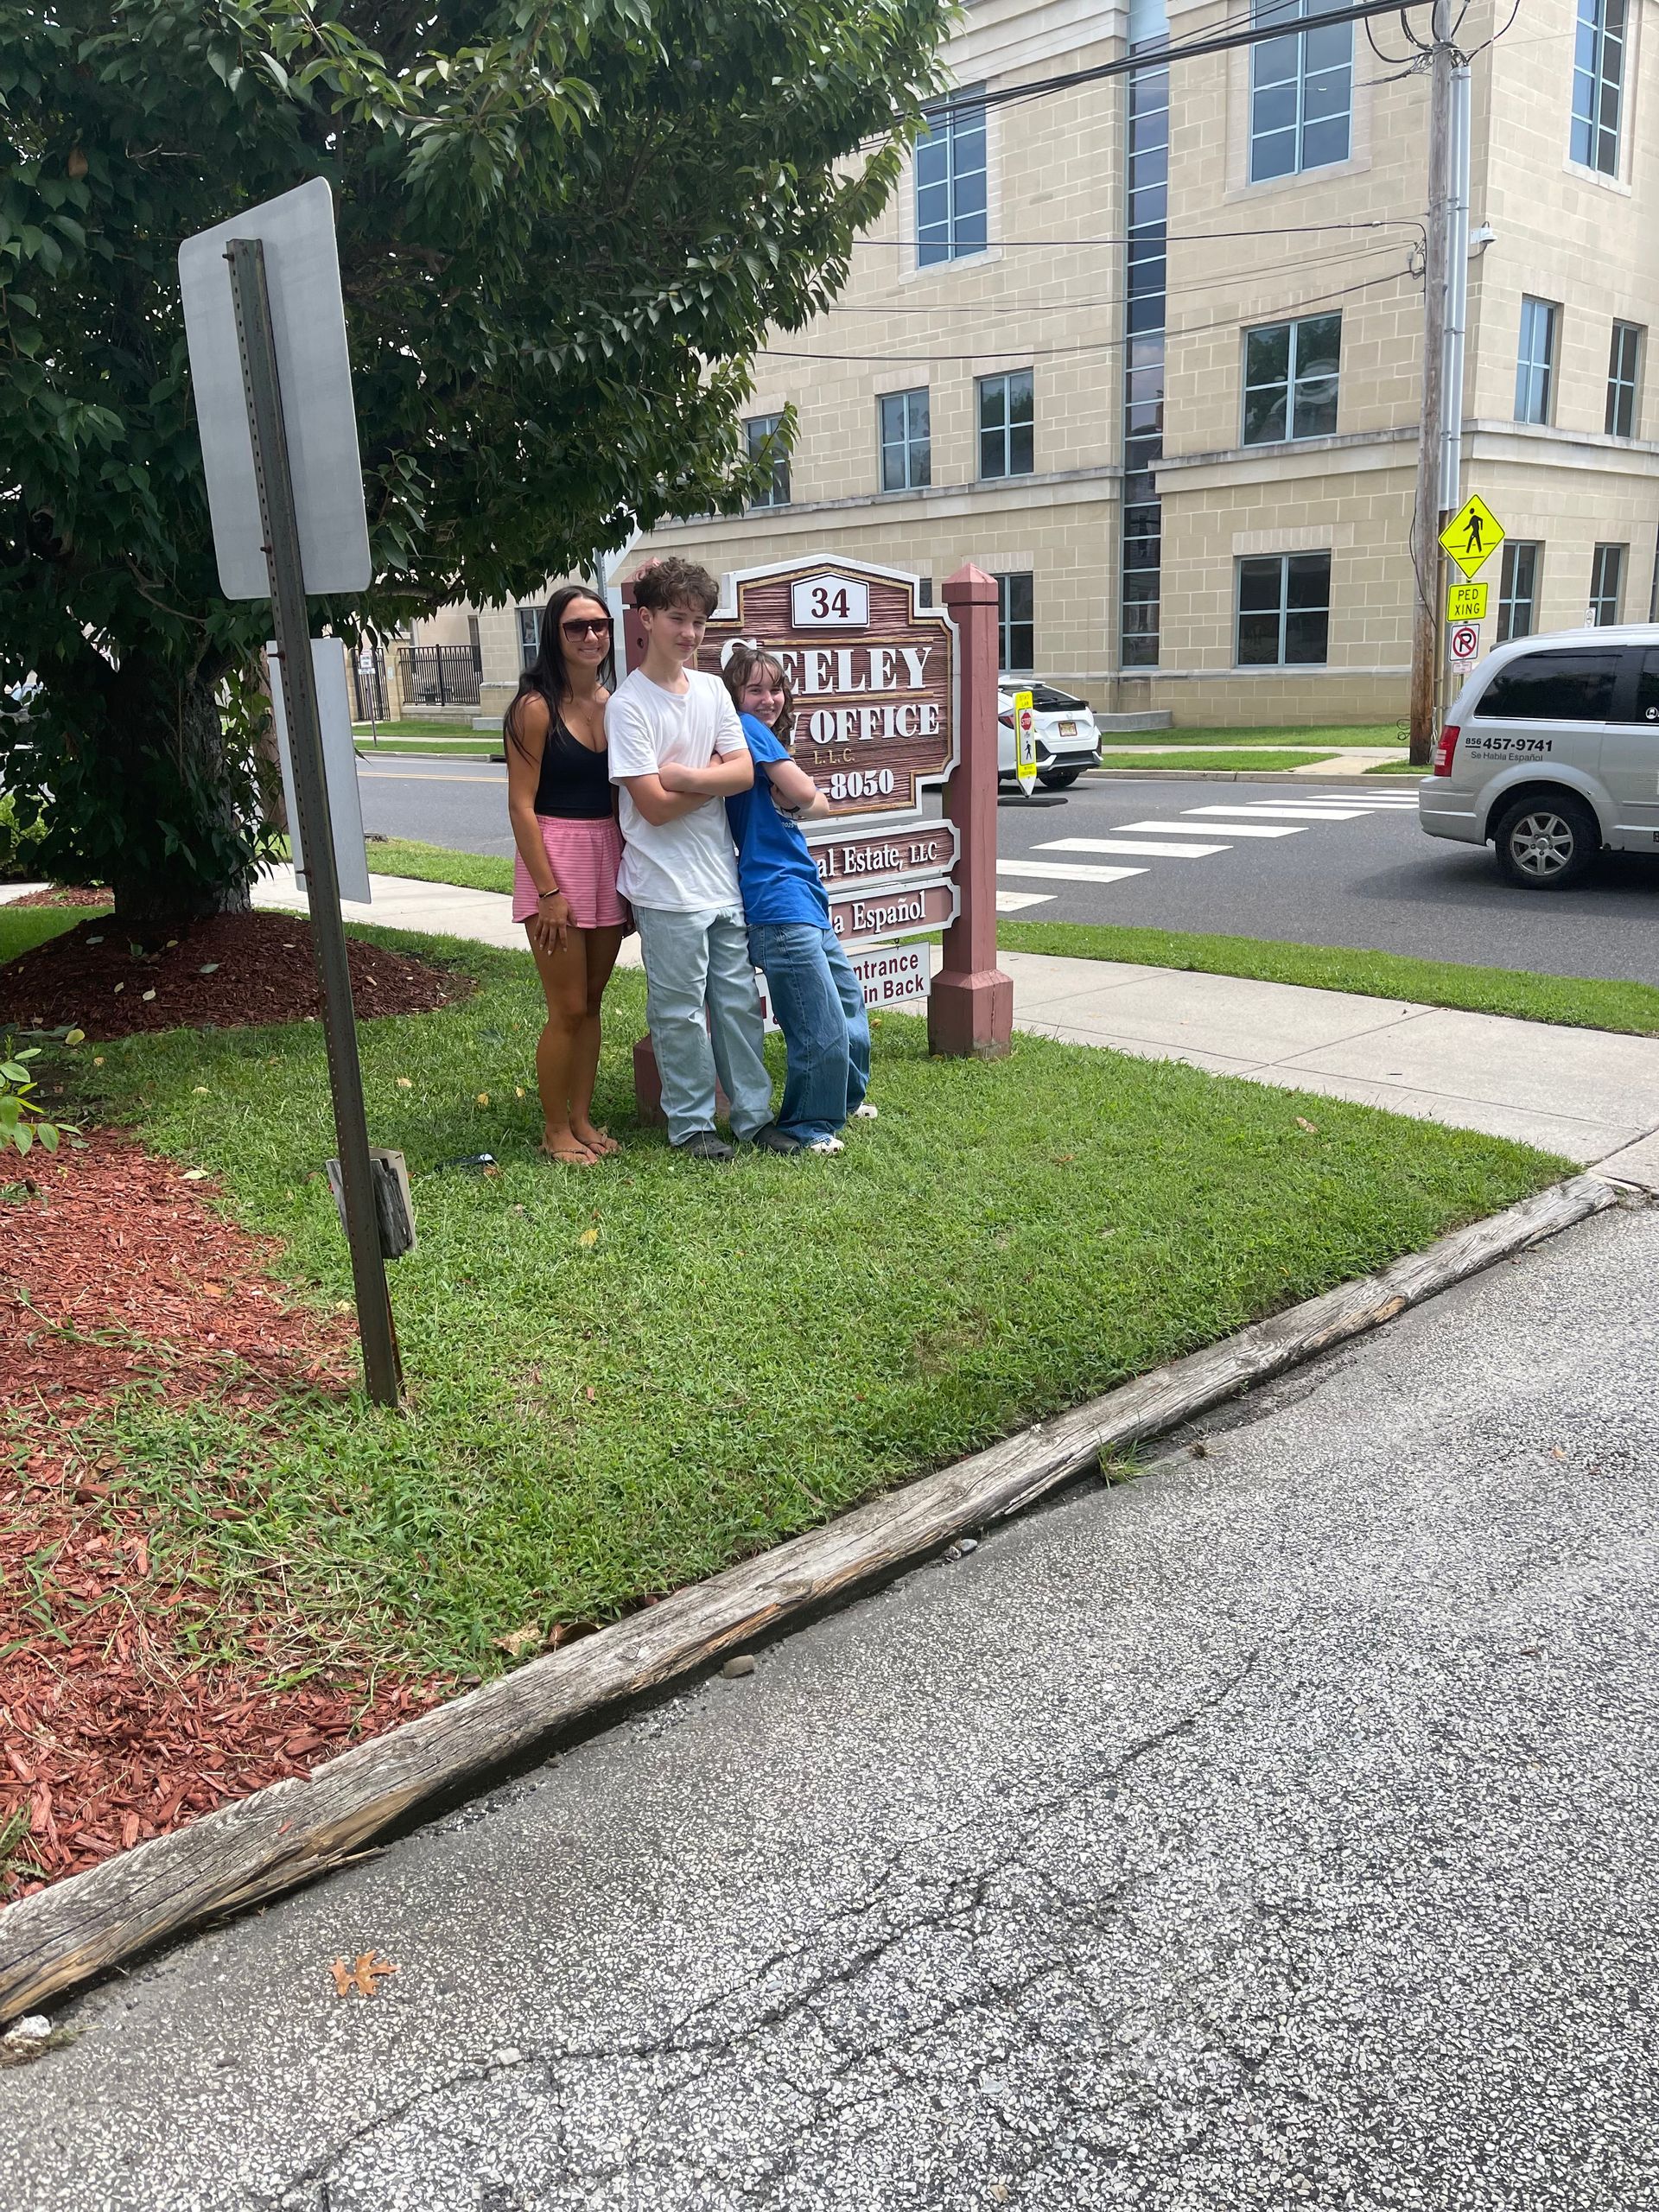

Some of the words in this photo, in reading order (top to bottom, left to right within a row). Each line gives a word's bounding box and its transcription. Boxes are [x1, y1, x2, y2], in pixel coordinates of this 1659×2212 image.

[810, 588, 850, 619] 34
[1454, 603, 1480, 615] XING
[1458, 588, 1478, 601] PED
[810, 703, 939, 745] OFFICE
[1471, 751, 1482, 760] Se
[1483, 752, 1507, 760] Habla
[1509, 753, 1543, 762] Español
[1483, 737, 1553, 752] 457-9741
[818, 769, 894, 800] -8050
[817, 848, 835, 879] al
[842, 843, 904, 874] Estate,
[909, 842, 938, 864] LLC
[852, 890, 926, 934] Español
[853, 953, 918, 981] ntrance
[863, 985, 879, 1004] in
[883, 974, 925, 1000] Back
